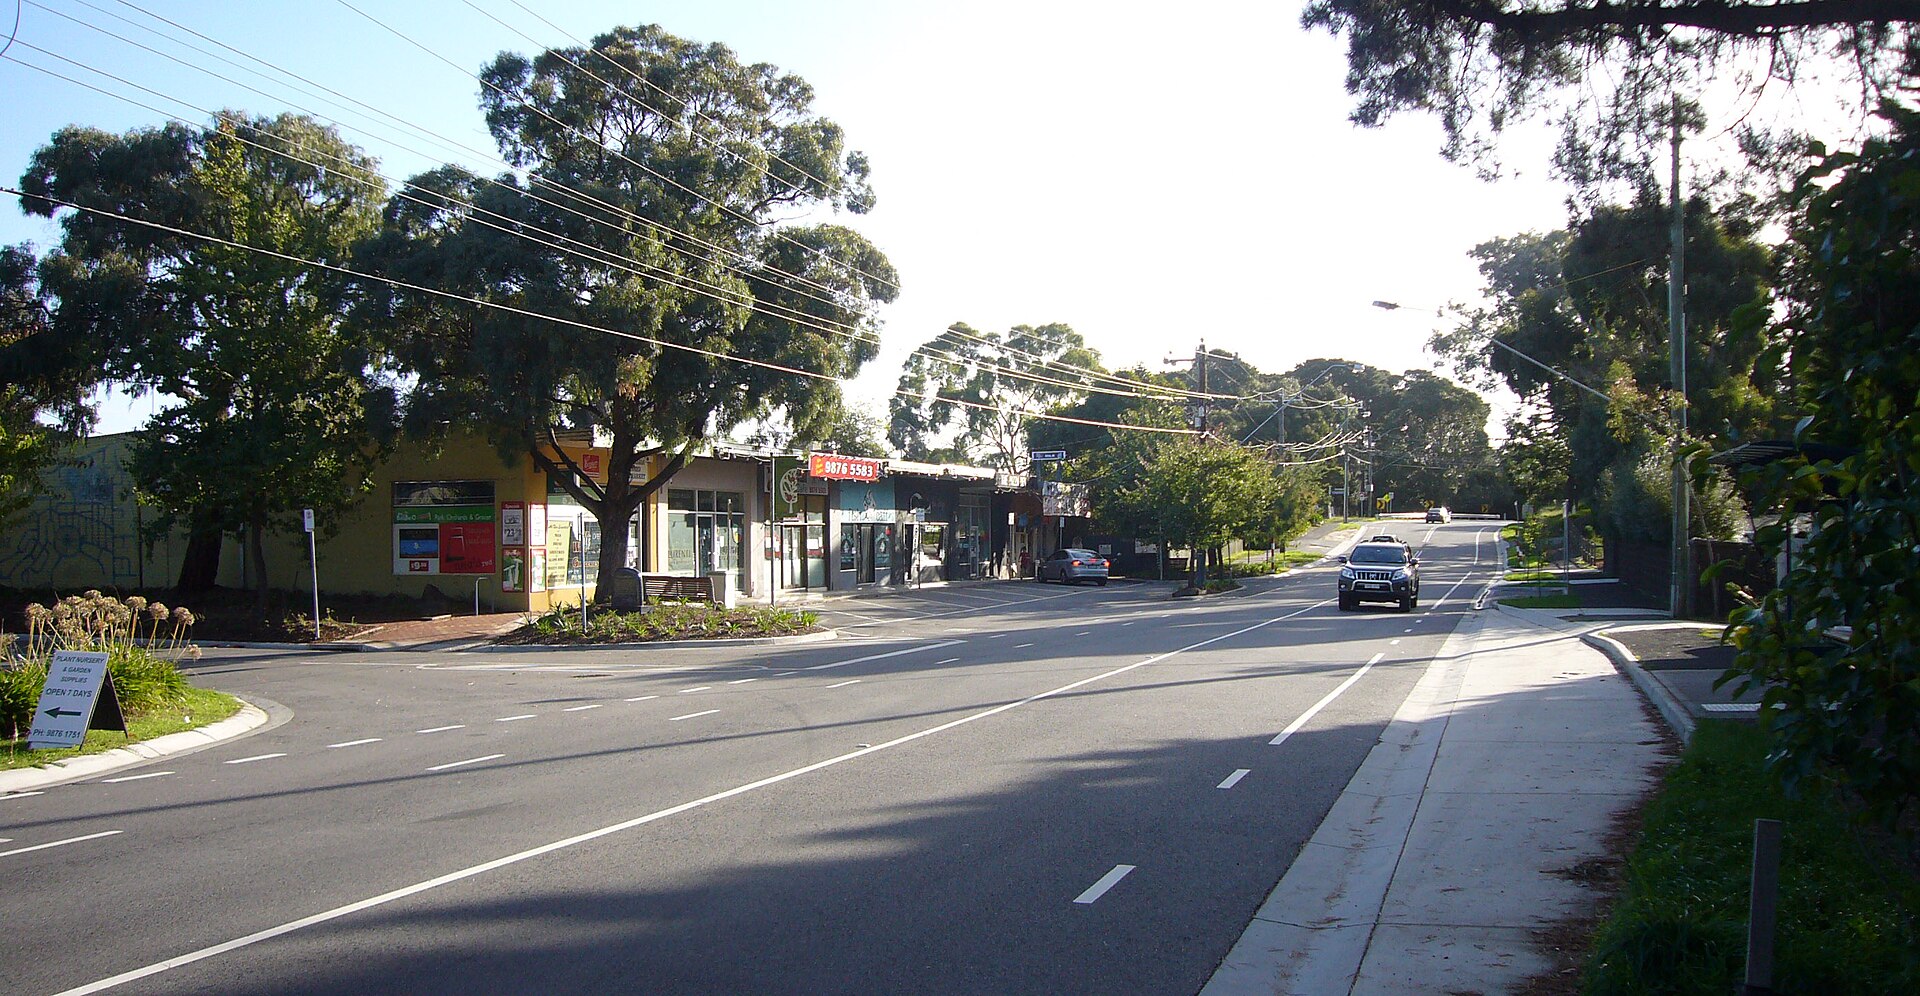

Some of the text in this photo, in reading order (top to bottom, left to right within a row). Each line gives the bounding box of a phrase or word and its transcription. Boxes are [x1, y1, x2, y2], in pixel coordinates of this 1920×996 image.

[825, 461, 848, 475] 9876
[850, 463, 873, 477] 5583
[46, 688, 66, 696] OPEN
[72, 689, 92, 698] DAYS
[33, 728, 44, 736] PH:
[64, 730, 81, 738] 1751
